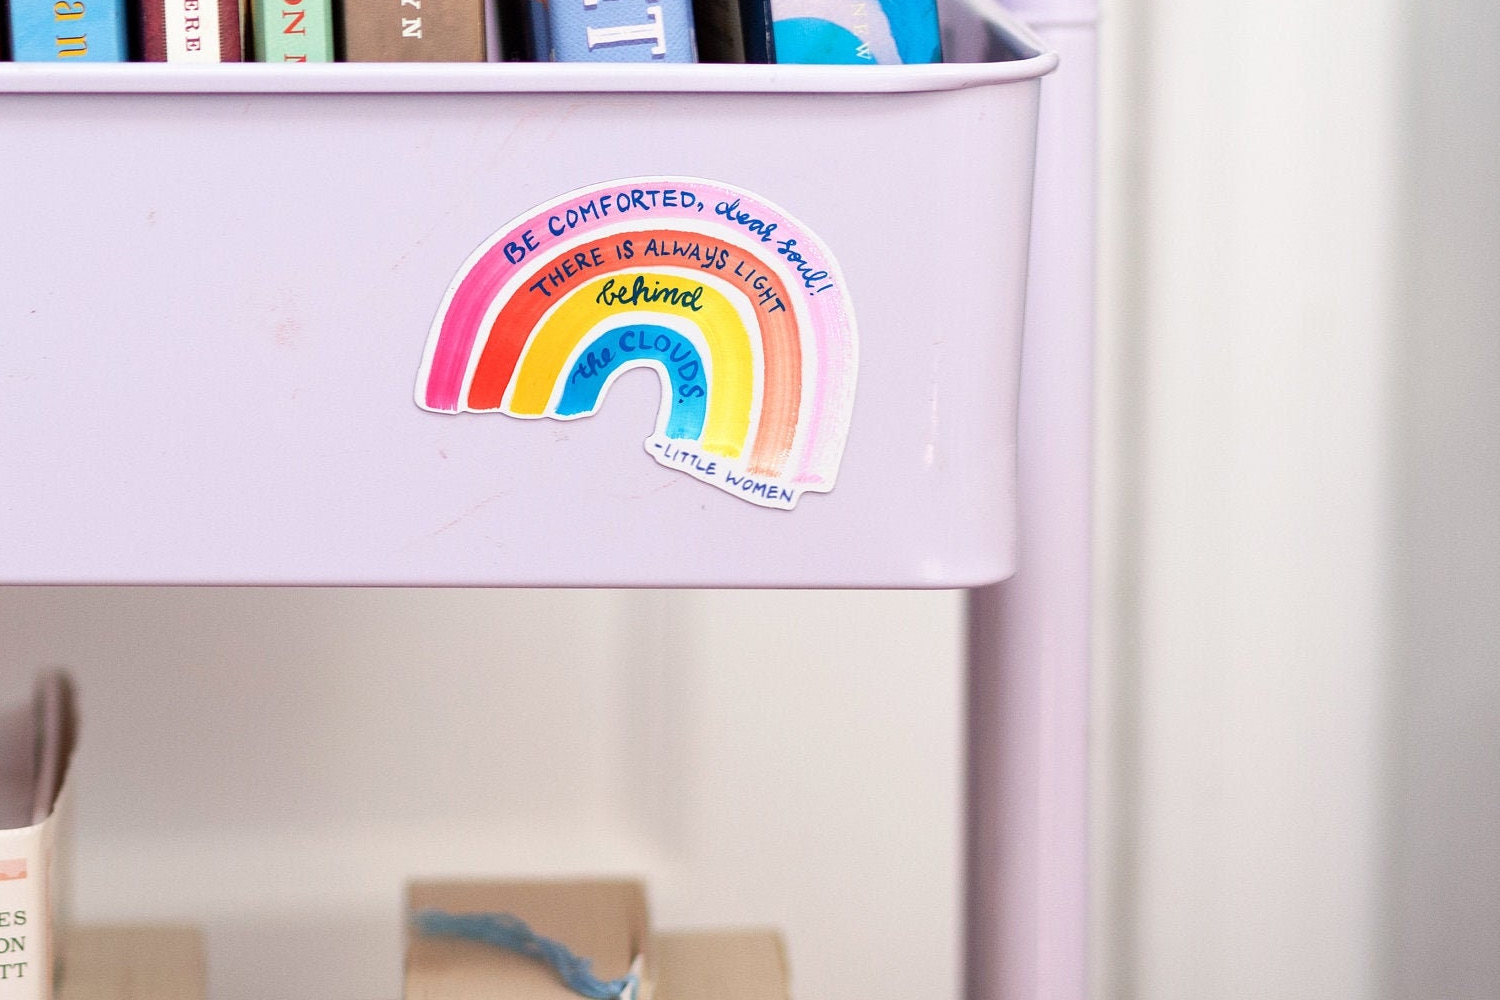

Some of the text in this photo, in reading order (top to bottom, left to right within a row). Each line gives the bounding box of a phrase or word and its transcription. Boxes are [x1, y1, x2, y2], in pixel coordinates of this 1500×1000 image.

[851, 2, 873, 61] NEW
[502, 189, 834, 297] BE COMFORTED, dear soul!
[529, 238, 787, 316] THERE IS ALWAYS LIGHT
[595, 275, 704, 313] behind
[571, 330, 706, 405] the CLOUDS.
[724, 469, 795, 504] WOMEN
